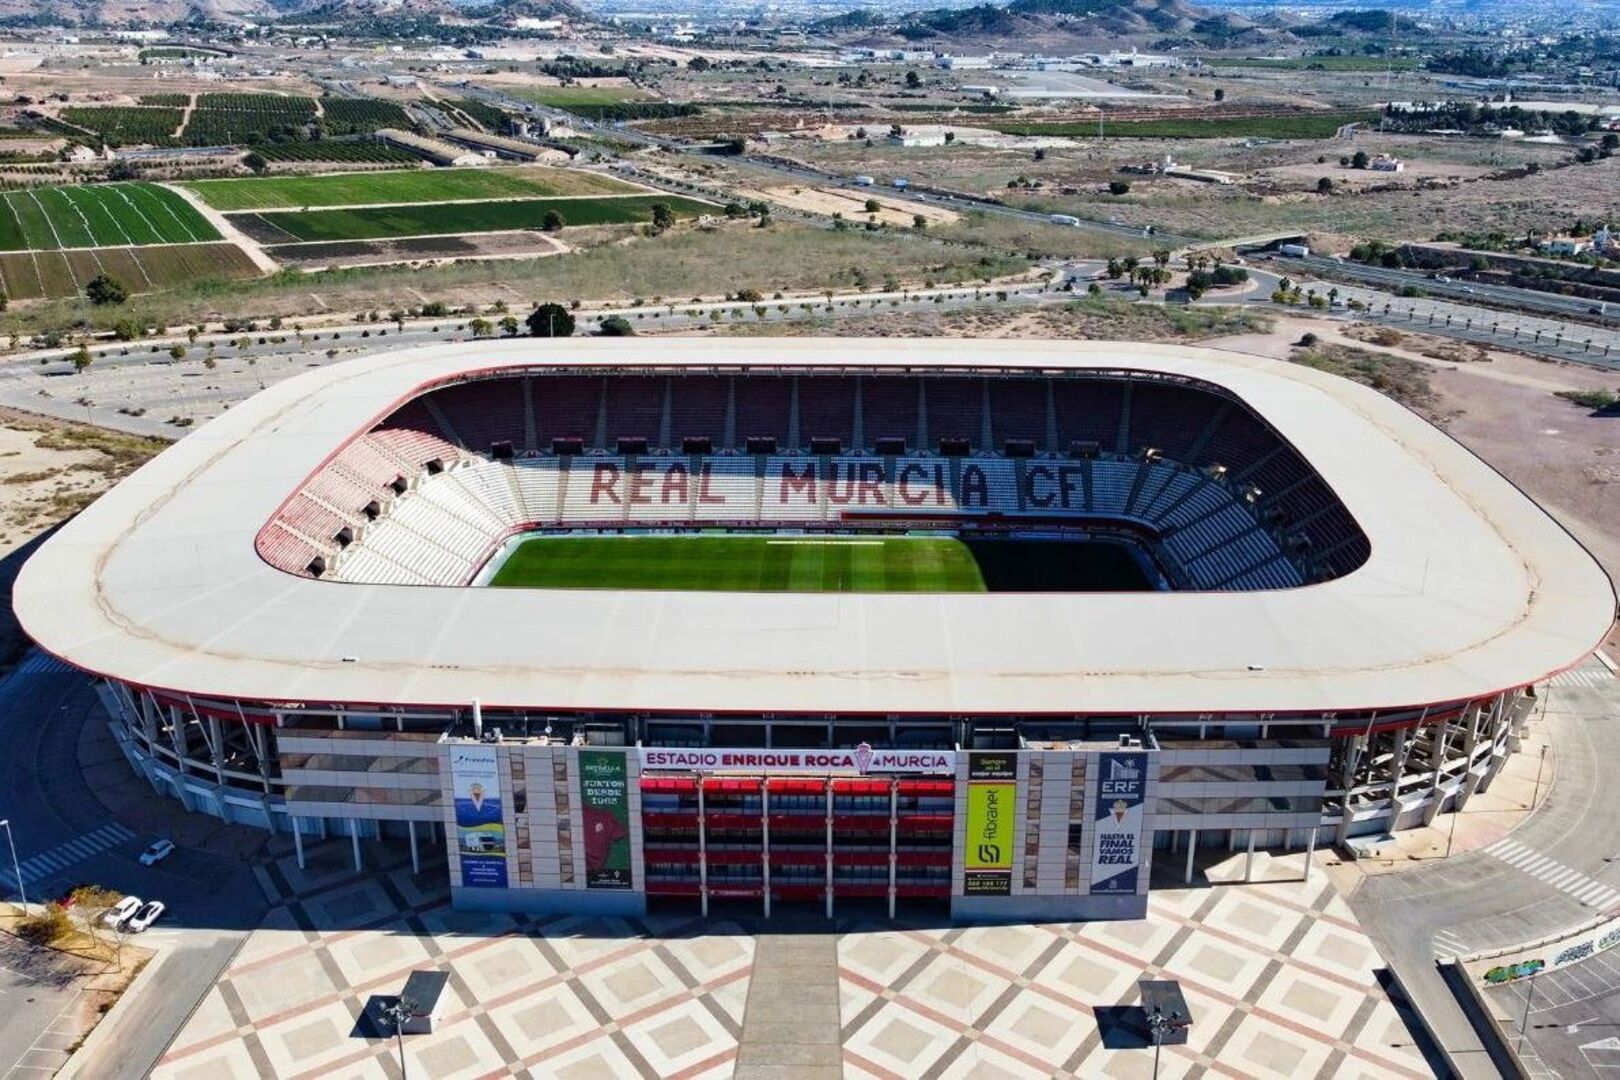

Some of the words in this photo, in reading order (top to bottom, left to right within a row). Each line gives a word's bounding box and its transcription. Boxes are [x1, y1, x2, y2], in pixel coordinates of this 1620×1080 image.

[591, 462, 726, 504] REAL
[780, 462, 988, 506] MURCIA
[1024, 465, 1083, 508] CF
[647, 753, 717, 766] ESTADIO
[722, 754, 800, 767] ENRIQUE
[805, 755, 854, 767] ROCA
[883, 755, 948, 768] MURCIA
[1102, 781, 1140, 793] ERF
[983, 789, 999, 841] fibranet
[1100, 840, 1135, 848] FINAL
[1098, 855, 1133, 865] REAL
